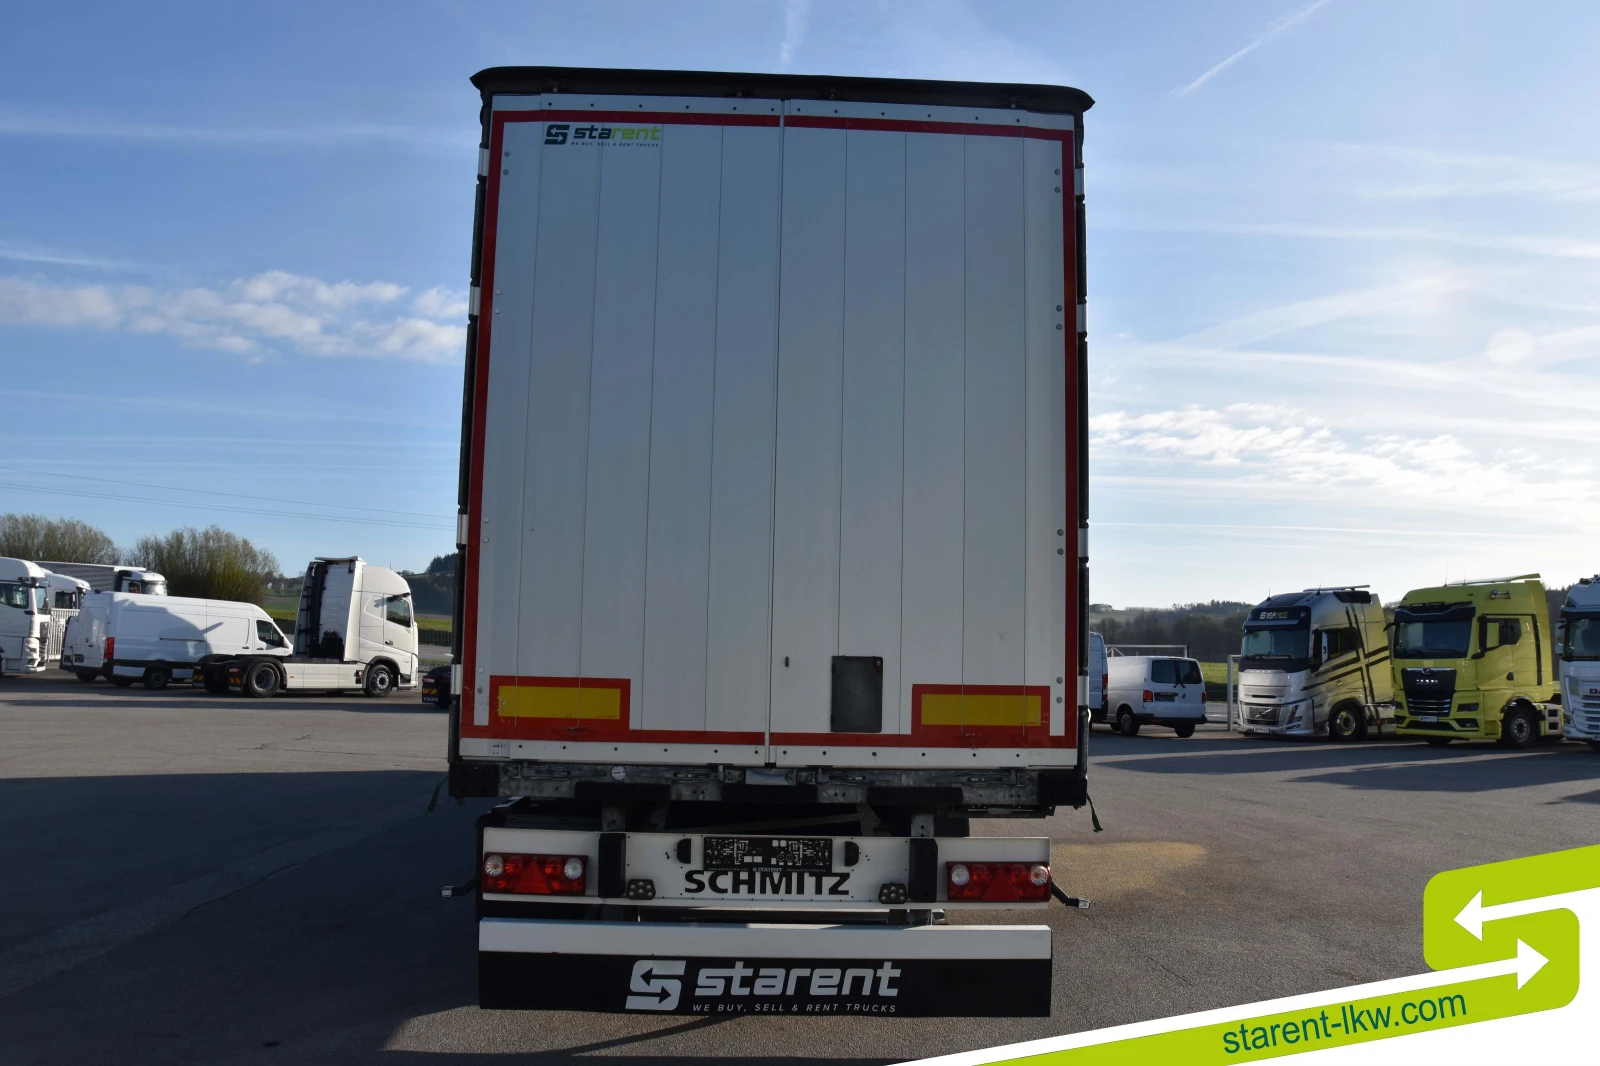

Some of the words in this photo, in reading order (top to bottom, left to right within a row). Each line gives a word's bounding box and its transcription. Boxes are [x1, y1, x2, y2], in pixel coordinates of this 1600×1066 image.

[573, 125, 661, 140] starent
[684, 869, 851, 895] SCHMITZ
[694, 961, 902, 996] starent
[693, 1004, 711, 1012] WE
[717, 1004, 746, 1013] BUY,
[754, 1004, 785, 1012] SELL
[792, 1004, 799, 1012] &
[806, 1004, 839, 1012] RENT
[846, 1003, 897, 1013] TRUCKS
